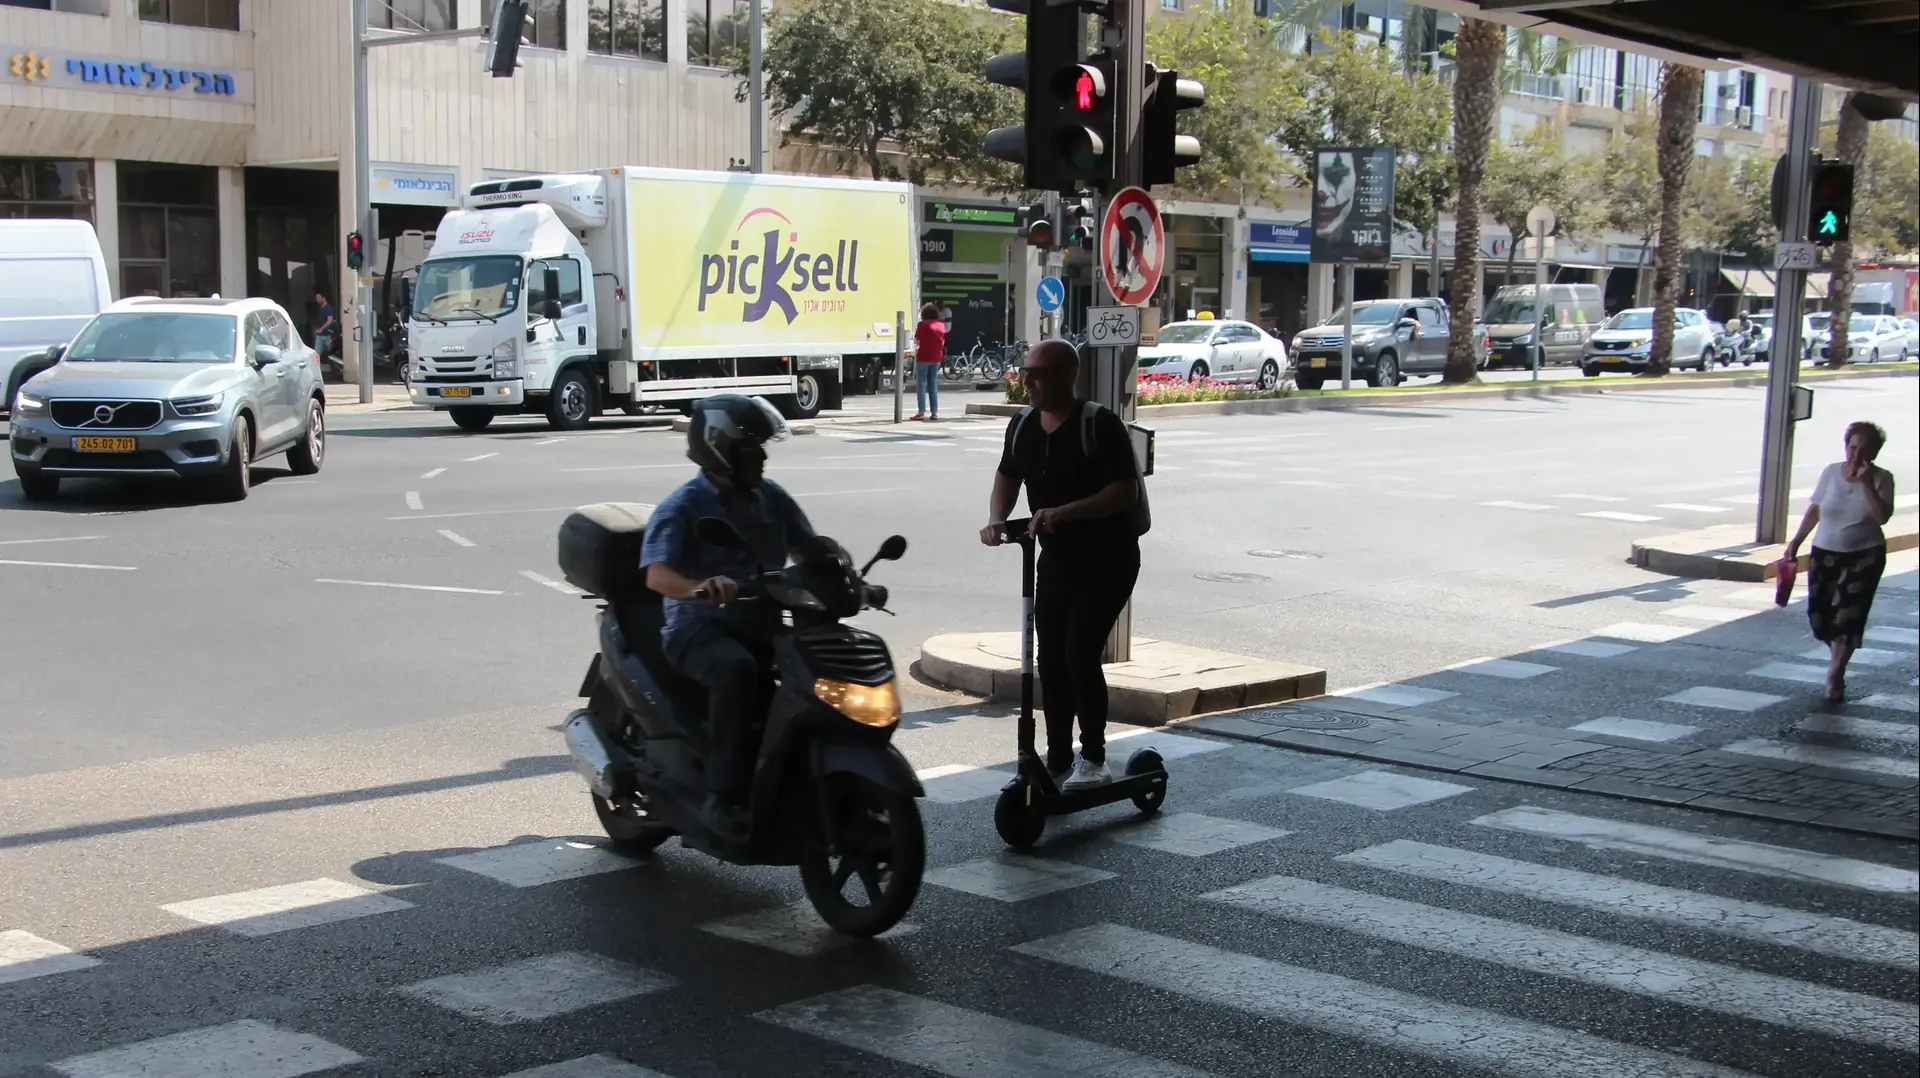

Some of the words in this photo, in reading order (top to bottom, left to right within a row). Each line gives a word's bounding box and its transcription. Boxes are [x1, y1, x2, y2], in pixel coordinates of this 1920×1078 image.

[66, 59, 235, 94] הבינלאומי
[394, 178, 451, 191] הבינלאומי
[482, 194, 507, 203] THERMO
[508, 192, 522, 200] KING
[461, 230, 495, 239] ISUZU
[1272, 225, 1299, 237] Leonidas
[968, 300, 979, 309] Any
[441, 345, 465, 353] ISUZU
